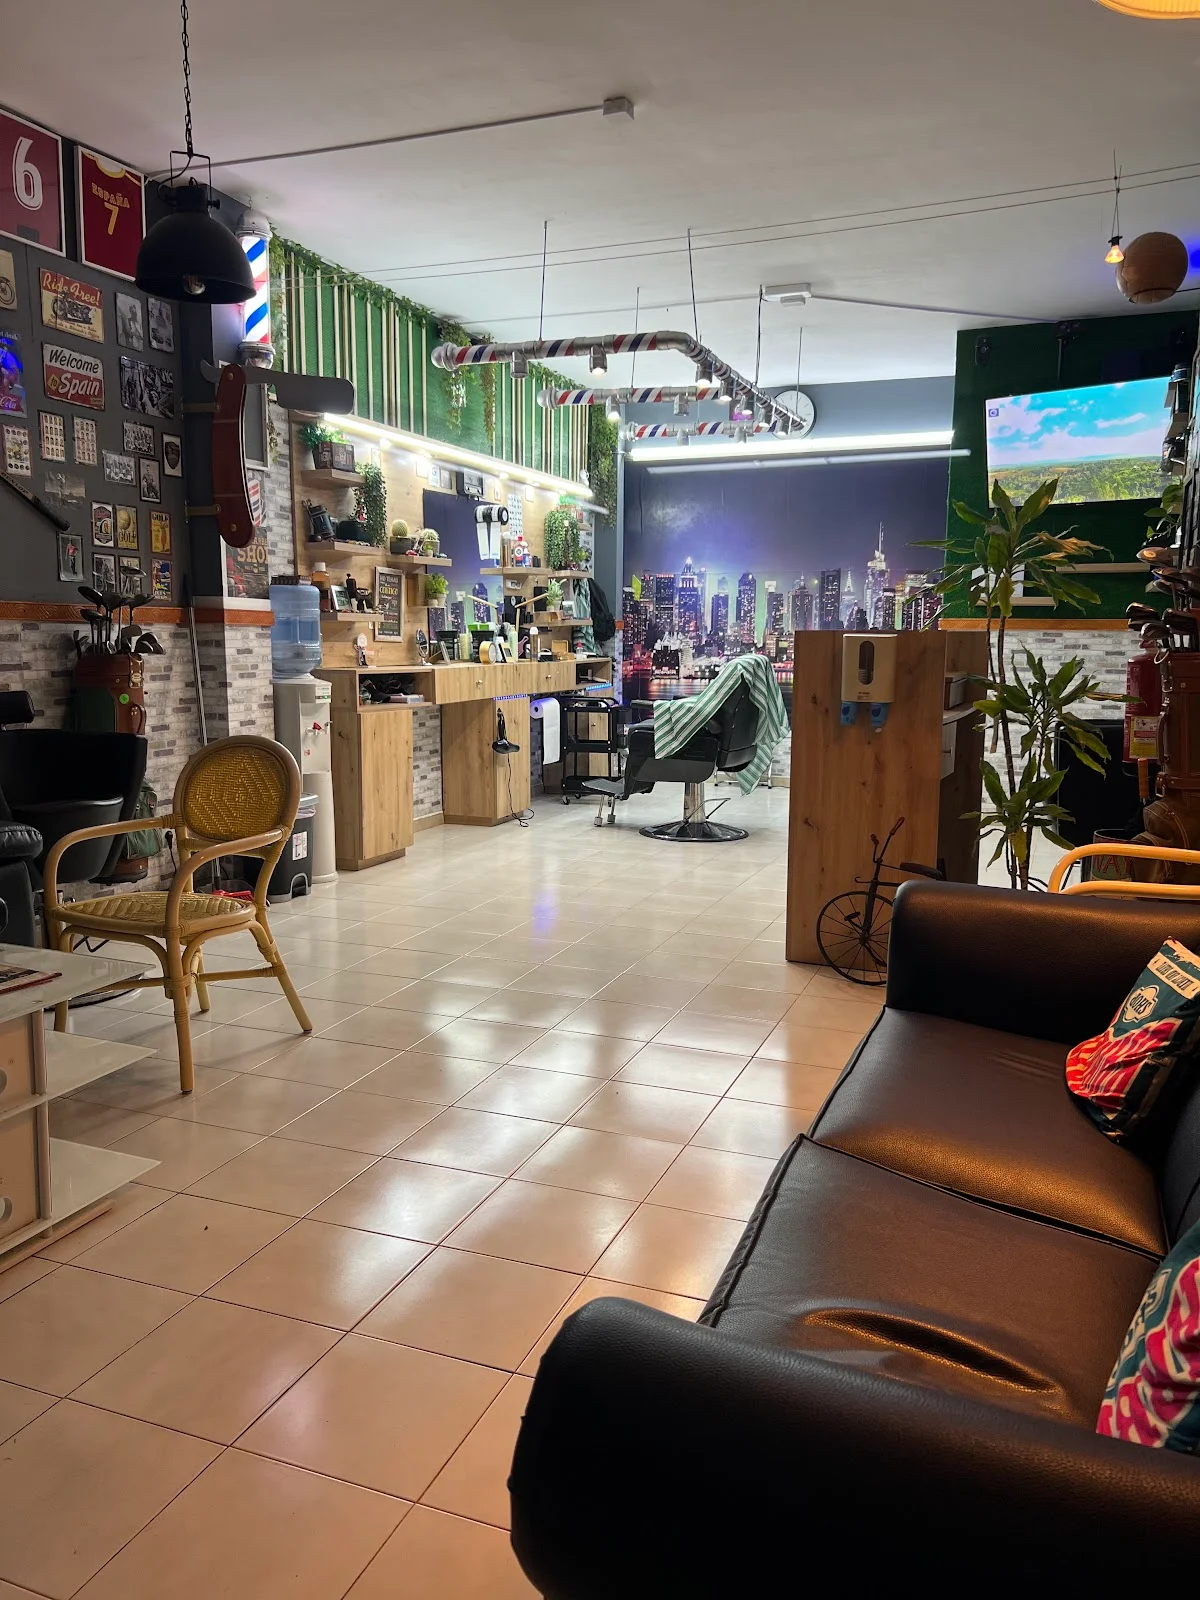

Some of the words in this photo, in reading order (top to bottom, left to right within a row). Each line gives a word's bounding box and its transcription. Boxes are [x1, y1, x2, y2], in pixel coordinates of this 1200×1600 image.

[12, 136, 43, 211] 6
[91, 183, 130, 208] ESPAÑA
[104, 202, 119, 235] 7
[42, 273, 69, 293] Ride
[70, 283, 100, 305] Free!
[50, 349, 99, 374] Welcome
[50, 377, 58, 387] to
[58, 373, 100, 399] Spain
[1, 471, 29, 495] DUNLOP
[118, 529, 137, 544] GOLF
